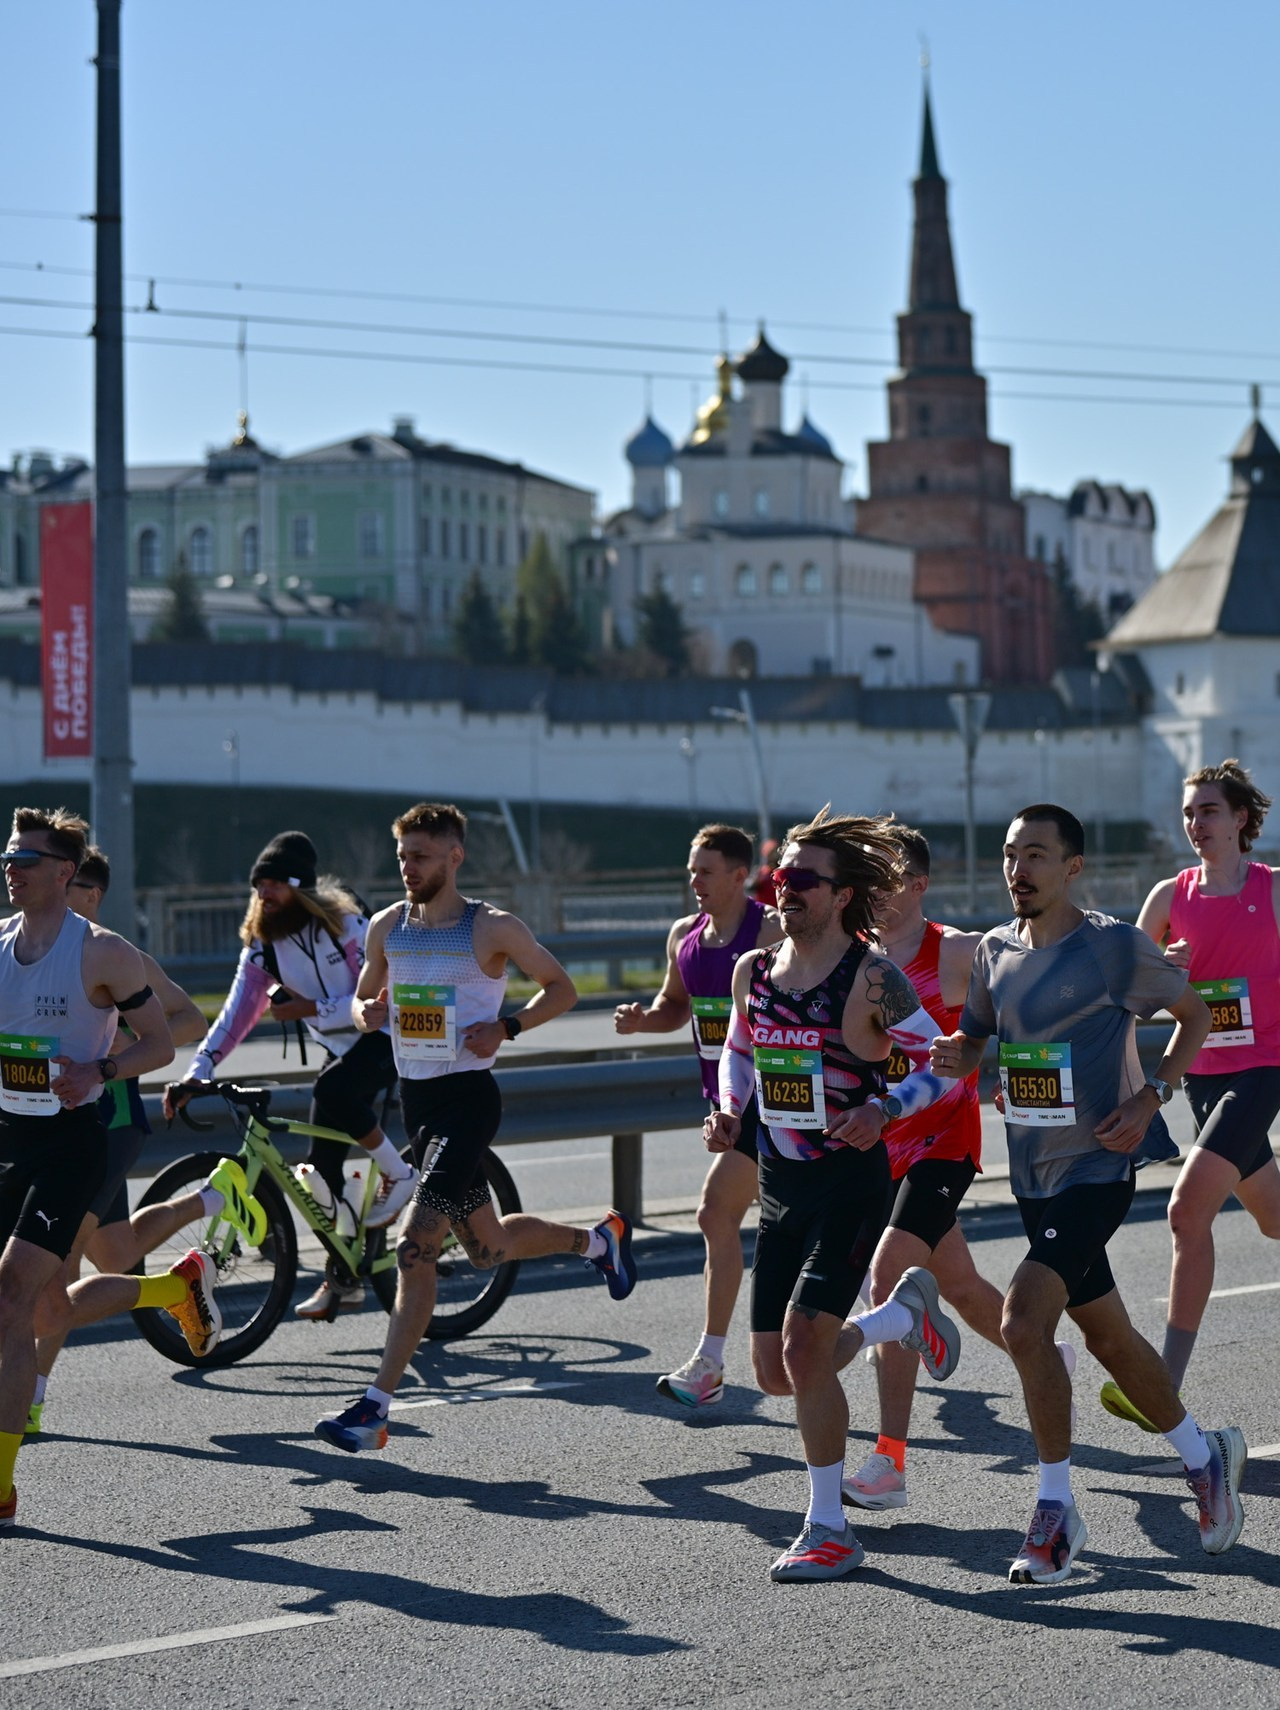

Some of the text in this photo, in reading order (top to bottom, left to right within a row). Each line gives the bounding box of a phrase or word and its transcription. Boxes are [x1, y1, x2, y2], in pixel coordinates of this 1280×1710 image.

[69, 604, 87, 739] ПОБЕДЫ!
[51, 630, 69, 739] С ДНЁМ
[36, 995, 66, 1005] PVLN
[36, 1009, 67, 1017] CREW
[401, 1012, 443, 1032] 22859
[701, 1022, 728, 1040] 1804
[753, 1027, 820, 1047] GANG
[3, 1063, 46, 1085] 18046
[764, 1079, 809, 1104] 16235
[1011, 1077, 1057, 1099] 15530
[1016, 1099, 1051, 1107] КОНСТАНТИН
[275, 1160, 336, 1233] SPECIALIZED
[1214, 1431, 1231, 1496] ON RUNNING
